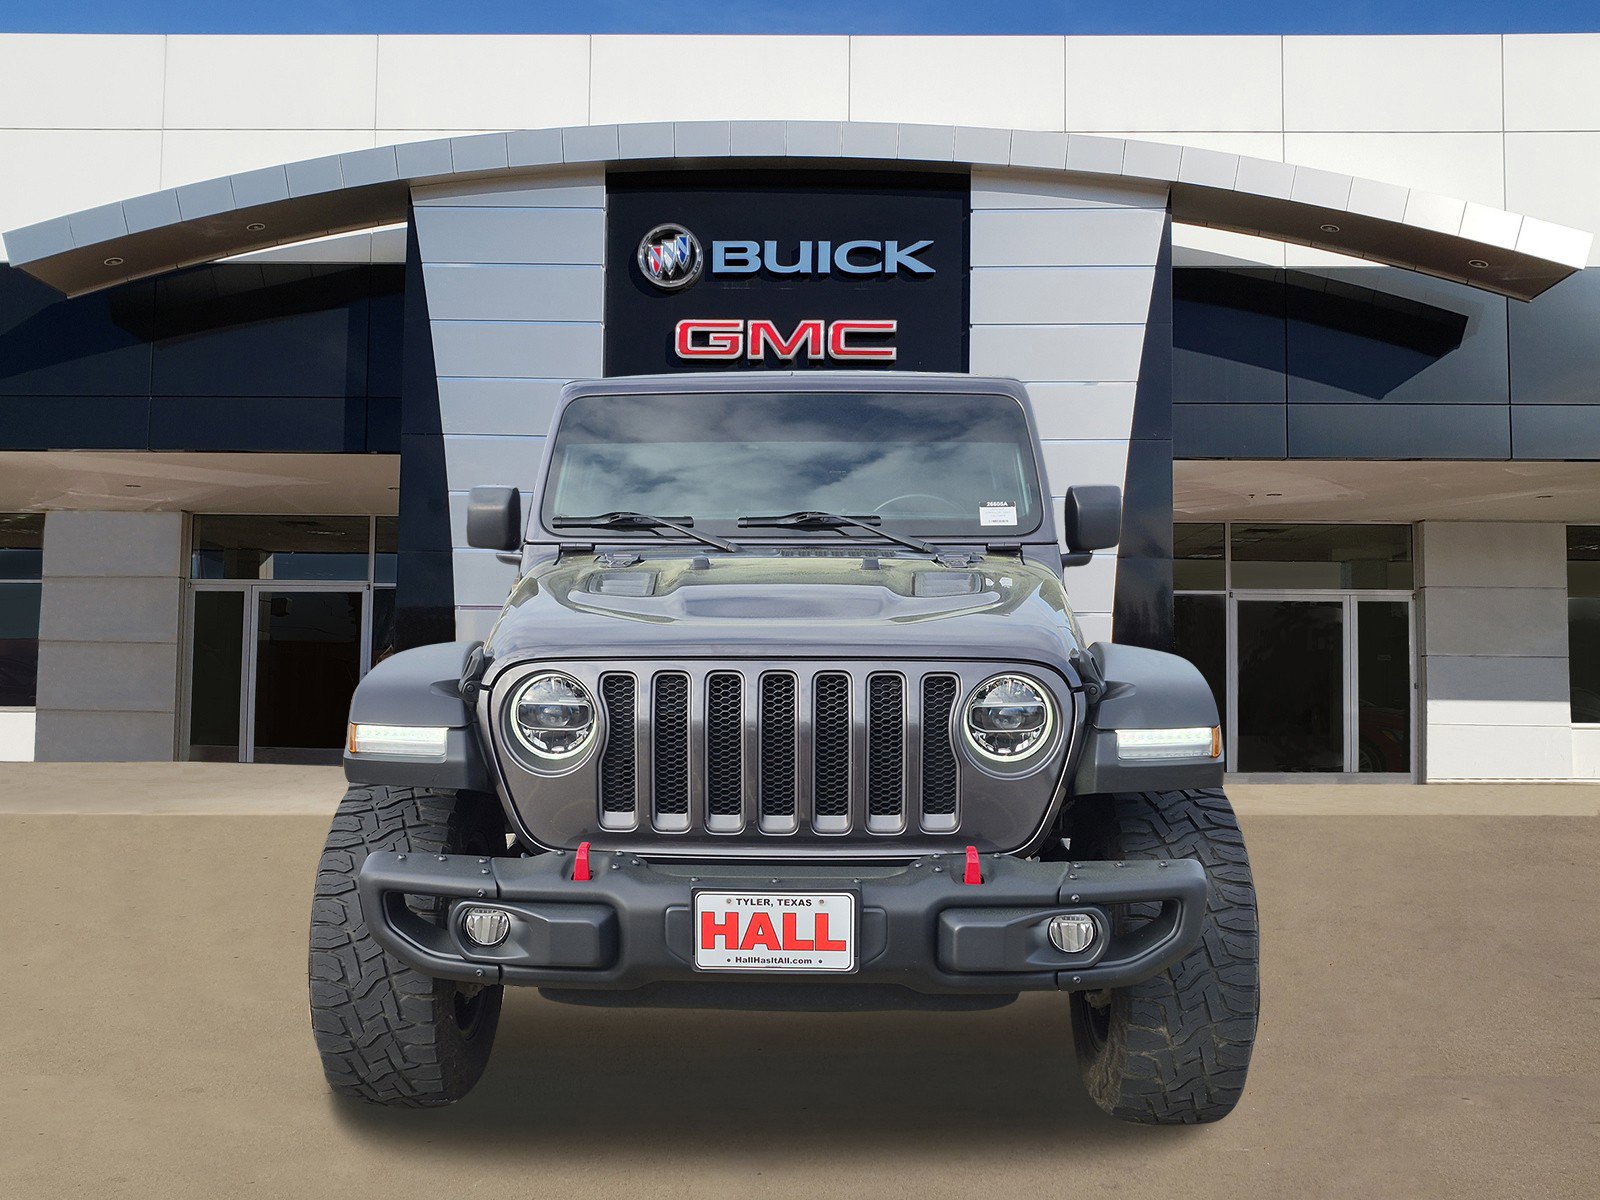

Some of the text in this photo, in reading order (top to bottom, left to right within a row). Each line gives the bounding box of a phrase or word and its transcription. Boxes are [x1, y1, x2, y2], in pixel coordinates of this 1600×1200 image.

[712, 240, 936, 274] BUICK
[674, 318, 898, 361] GMC
[736, 898, 812, 907] TYLER, TEXAS
[701, 911, 846, 951] HALL
[735, 956, 812, 964] HallHasItAll.com
